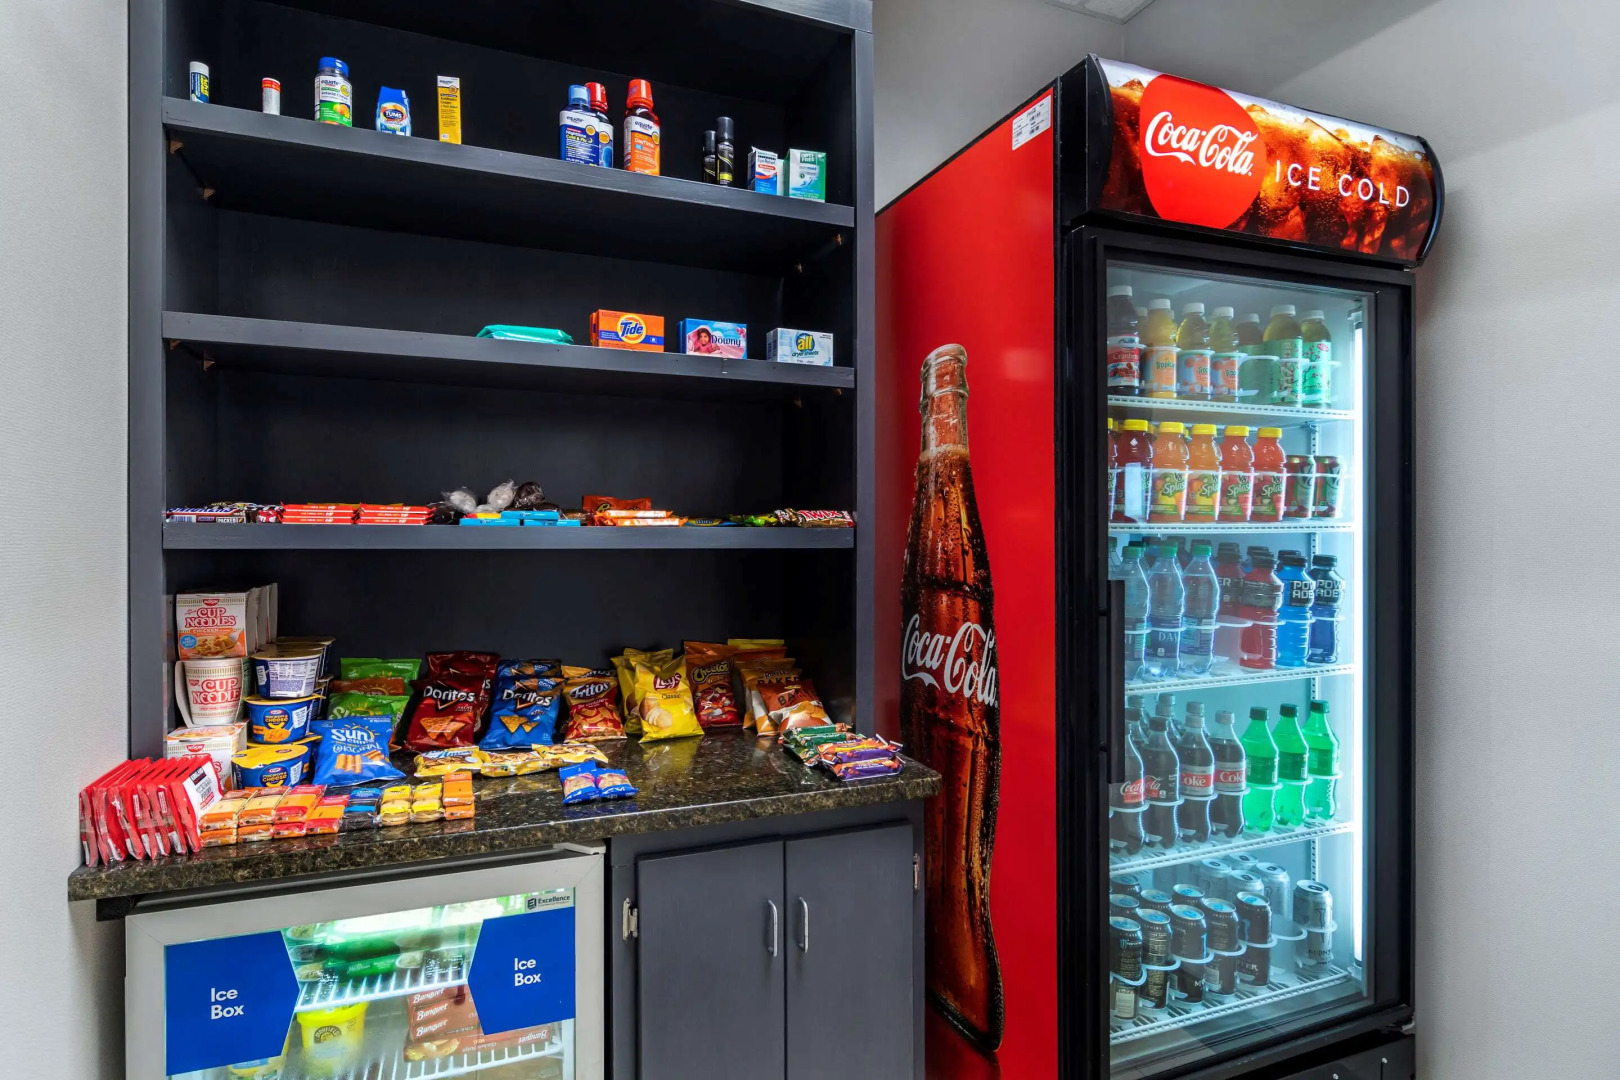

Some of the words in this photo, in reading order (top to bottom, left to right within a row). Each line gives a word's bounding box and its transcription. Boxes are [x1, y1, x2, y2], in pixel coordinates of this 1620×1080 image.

[385, 111, 402, 119] TUMS
[635, 121, 653, 130] equate
[1145, 111, 1258, 177] Coca-Cola
[1275, 160, 1322, 191] ICE
[1338, 174, 1410, 207] COLD
[621, 322, 643, 338] Tide
[711, 335, 741, 348] Downy
[797, 334, 813, 352] all
[798, 509, 843, 522] TWIX
[197, 607, 226, 618] CUP
[185, 616, 236, 628] NOODLES
[903, 613, 998, 708] Coca-Cola
[693, 662, 730, 683] Cheetos
[202, 677, 239, 692] CUP
[571, 682, 611, 699] Fritos
[191, 690, 241, 705] NOODLE
[424, 686, 475, 702] Doritos
[502, 688, 553, 706] Doritos
[538, 896, 571, 905] Excellence
[514, 958, 537, 972] Ice
[514, 973, 542, 988] Box
[210, 987, 238, 1003] Ice
[413, 989, 444, 1004] Banquet
[210, 1004, 244, 1021] Box
[416, 1004, 448, 1021] Banquet
[416, 1020, 448, 1037] Banquet
